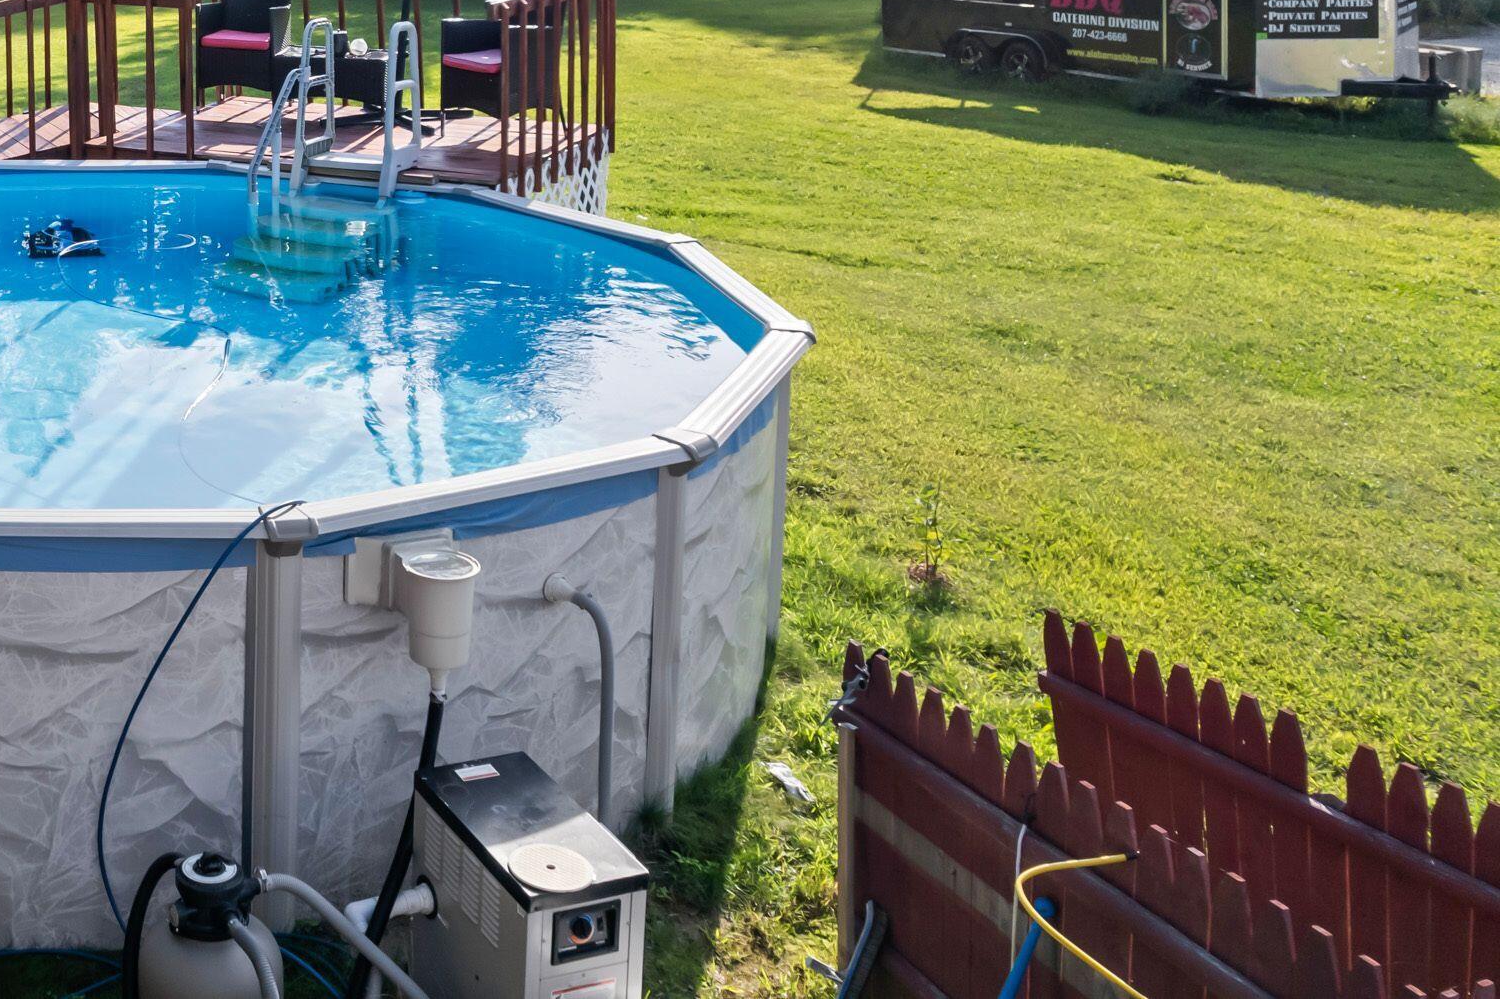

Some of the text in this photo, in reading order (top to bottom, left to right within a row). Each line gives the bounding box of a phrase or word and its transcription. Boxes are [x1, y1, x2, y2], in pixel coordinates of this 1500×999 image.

[1053, 11, 1160, 32] CATERING DIVISION
[1268, 24, 1285, 34] DJ
